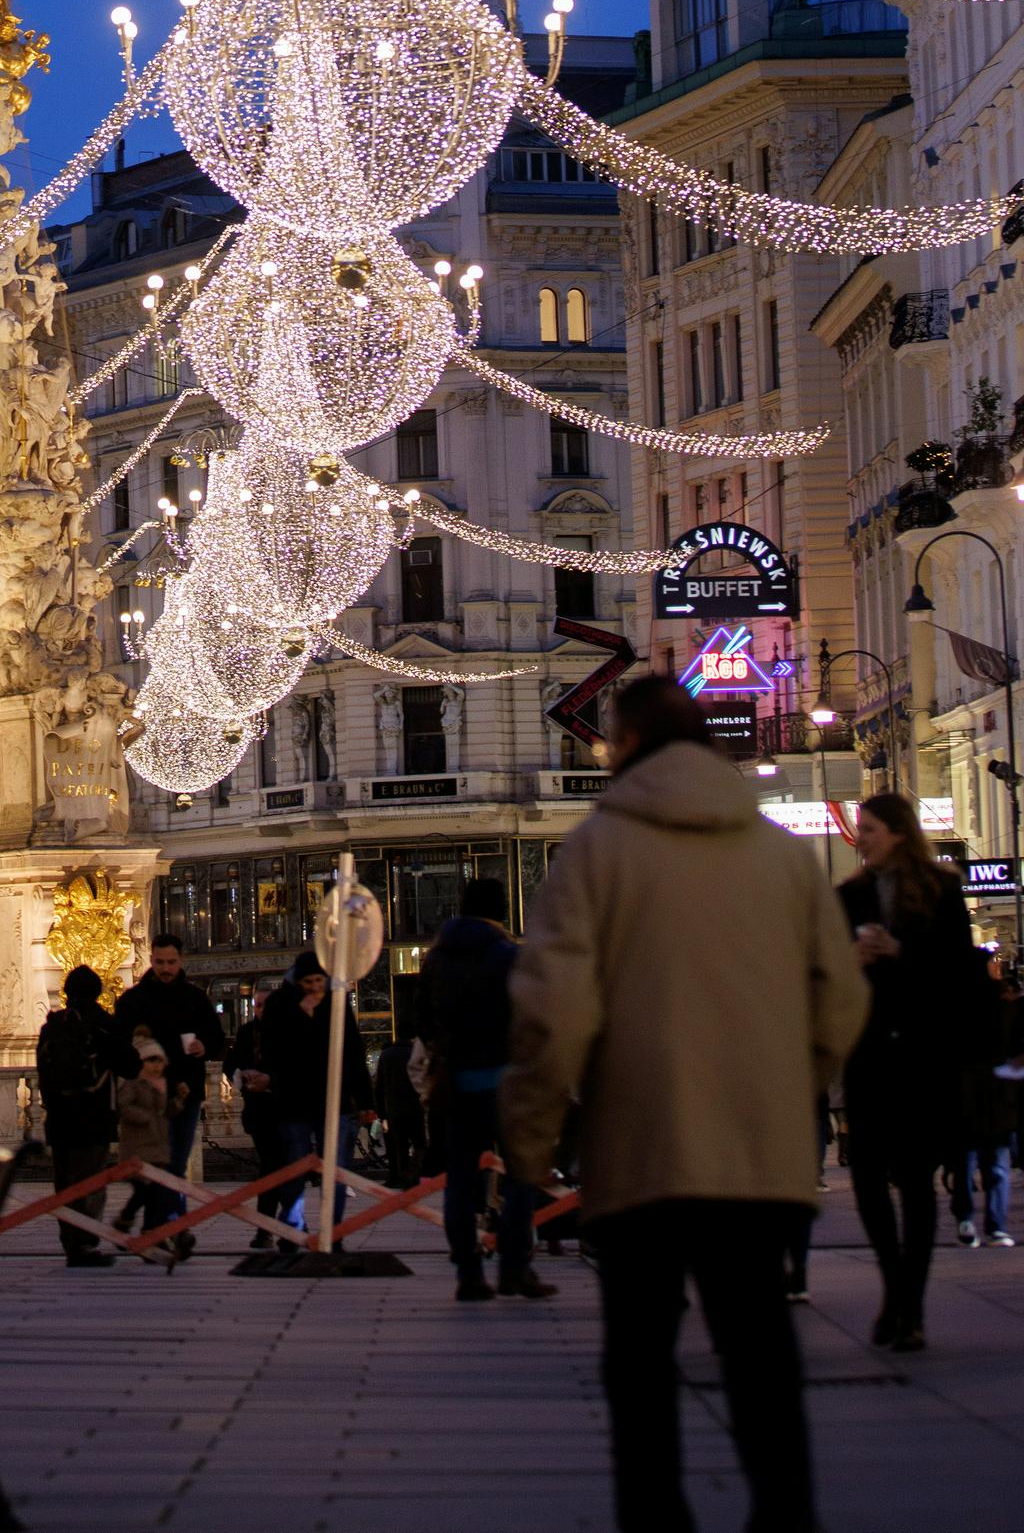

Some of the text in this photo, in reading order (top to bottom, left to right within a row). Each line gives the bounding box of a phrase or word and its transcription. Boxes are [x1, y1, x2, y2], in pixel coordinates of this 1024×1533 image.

[686, 580, 762, 598] BUFFET
[393, 784, 425, 795] BRAUN
[970, 864, 1008, 881] IWC
[961, 883, 1016, 892] CHAFFHAUSE
